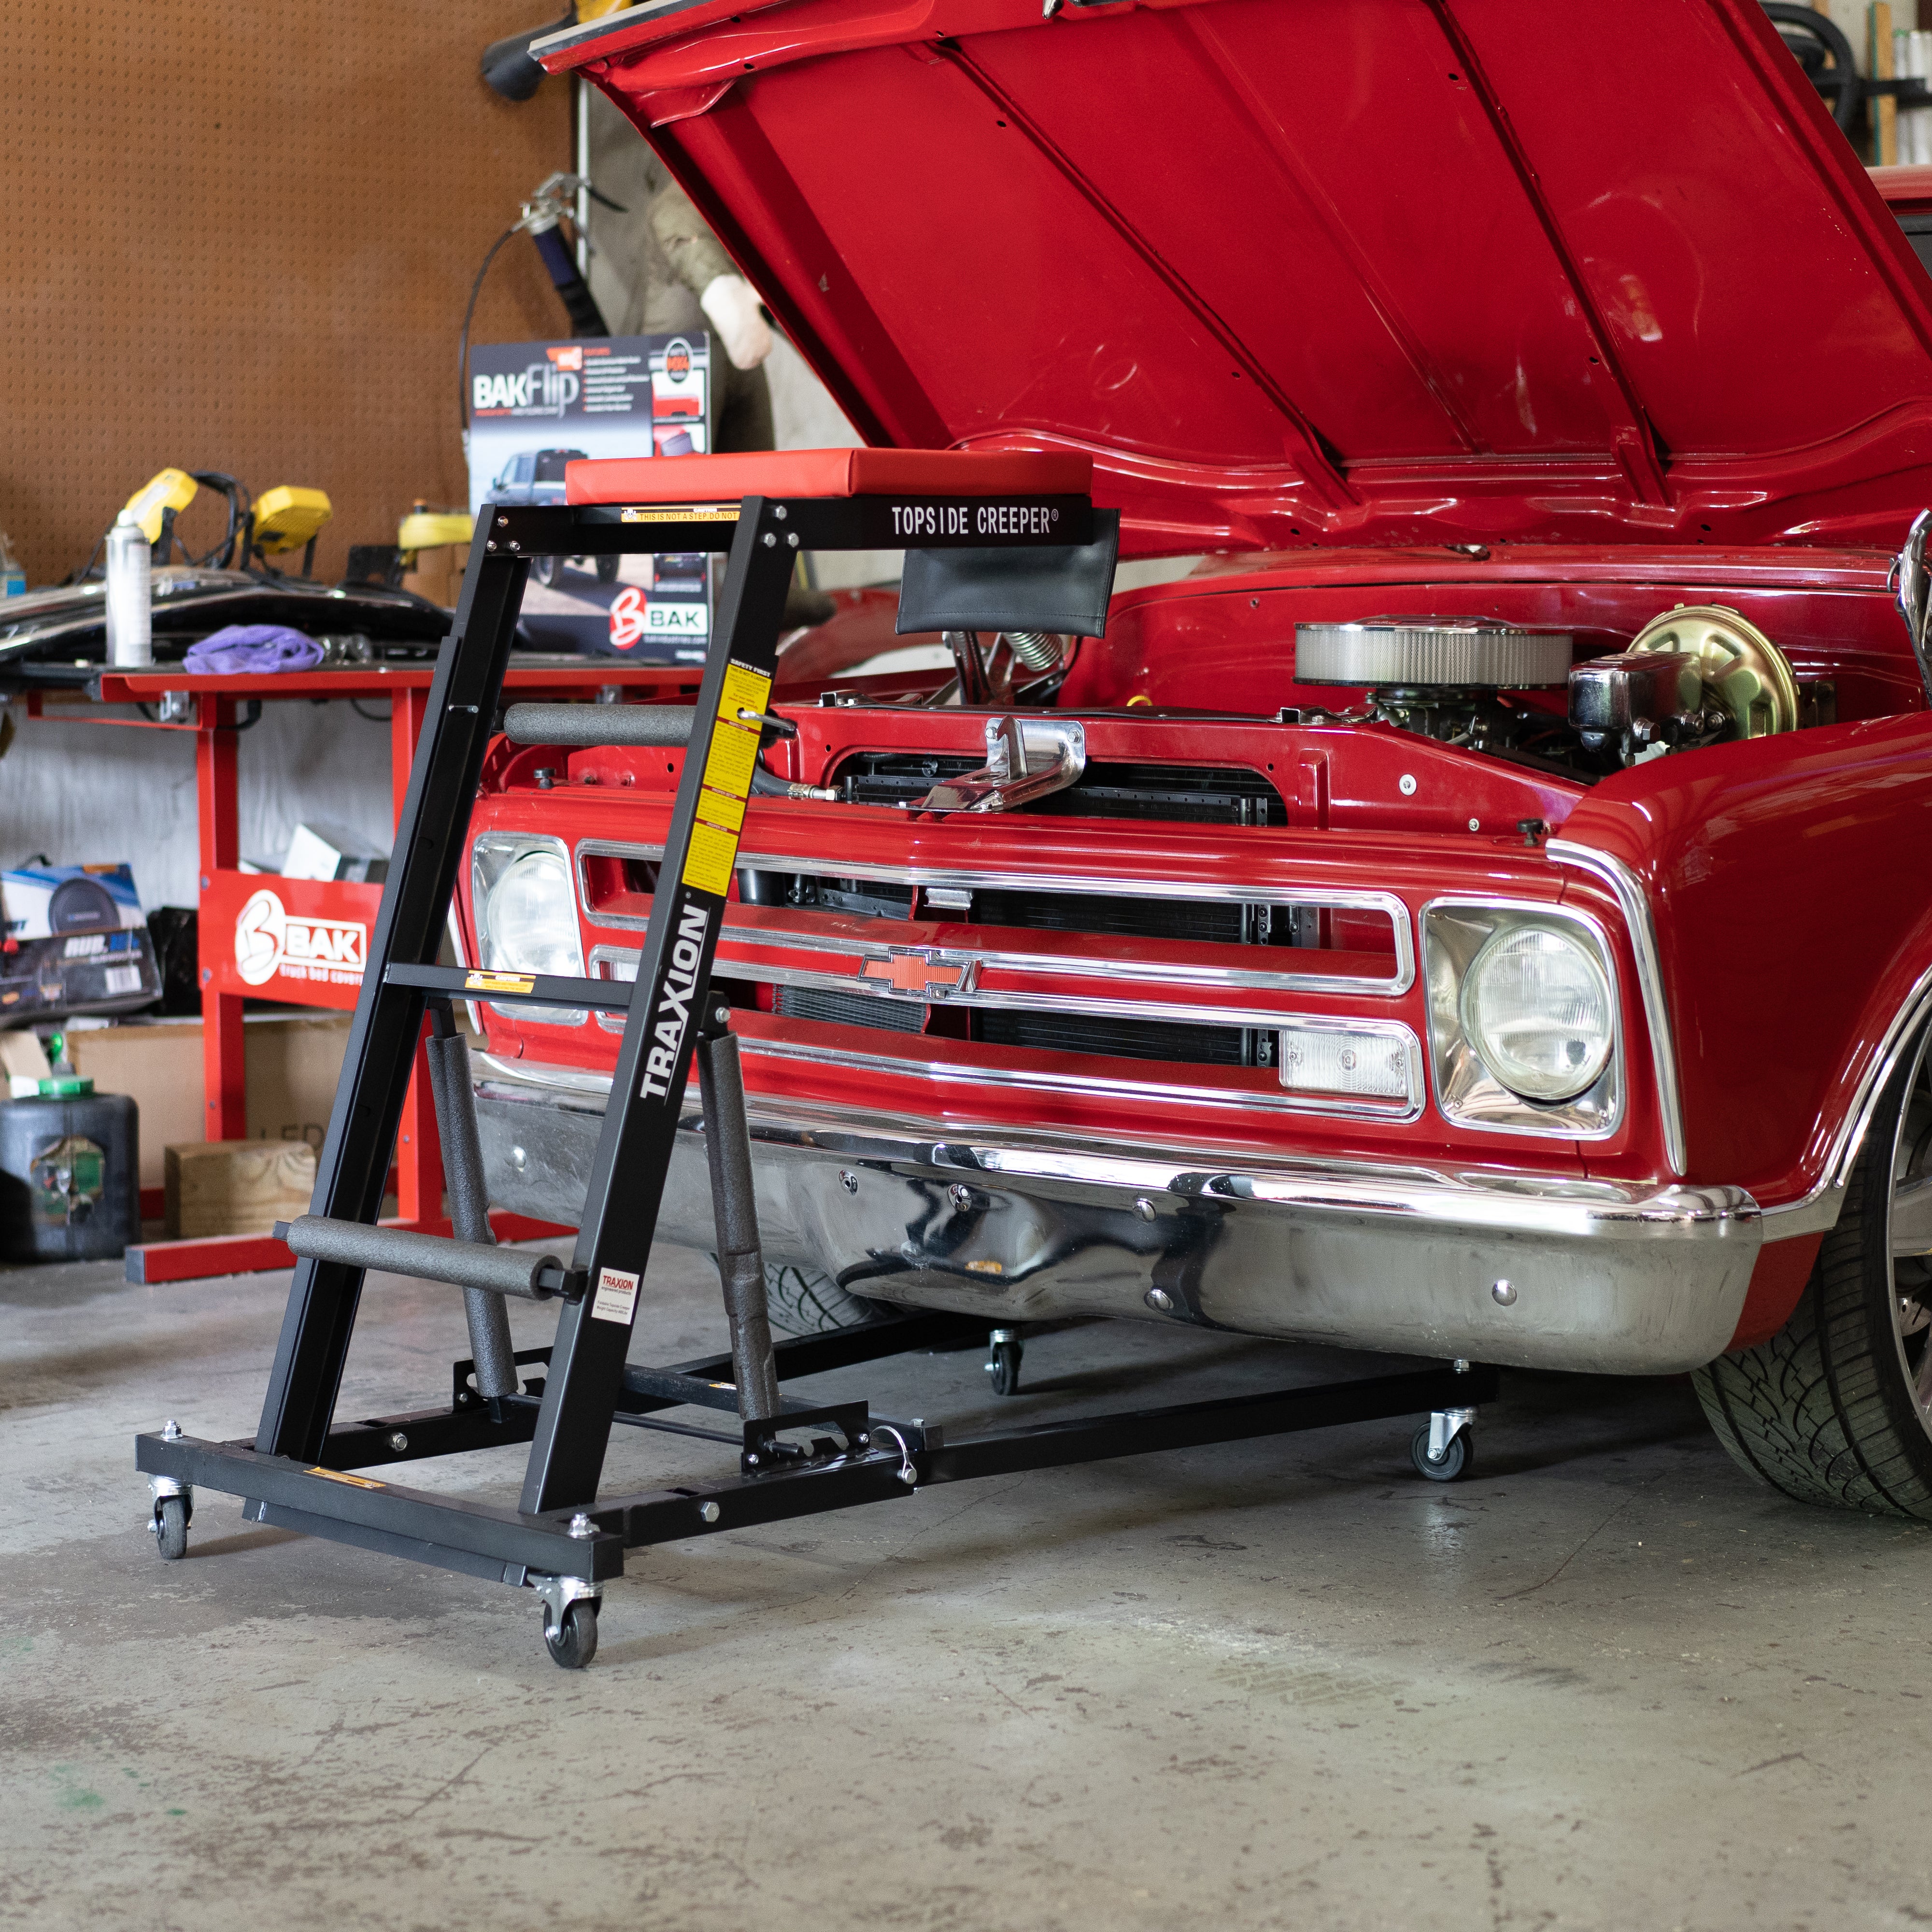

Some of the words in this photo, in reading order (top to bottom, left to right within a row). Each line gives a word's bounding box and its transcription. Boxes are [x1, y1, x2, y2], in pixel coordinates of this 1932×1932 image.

[474, 363, 580, 418] BAKFlip
[892, 507, 968, 534] TOPSIDE
[651, 610, 700, 628] BAK
[731, 658, 753, 670] SAFETY
[753, 667, 771, 677] FIRST
[286, 924, 360, 964] BAK
[640, 905, 709, 1098] TRAXION
[603, 1275, 634, 1291] TRAXION
